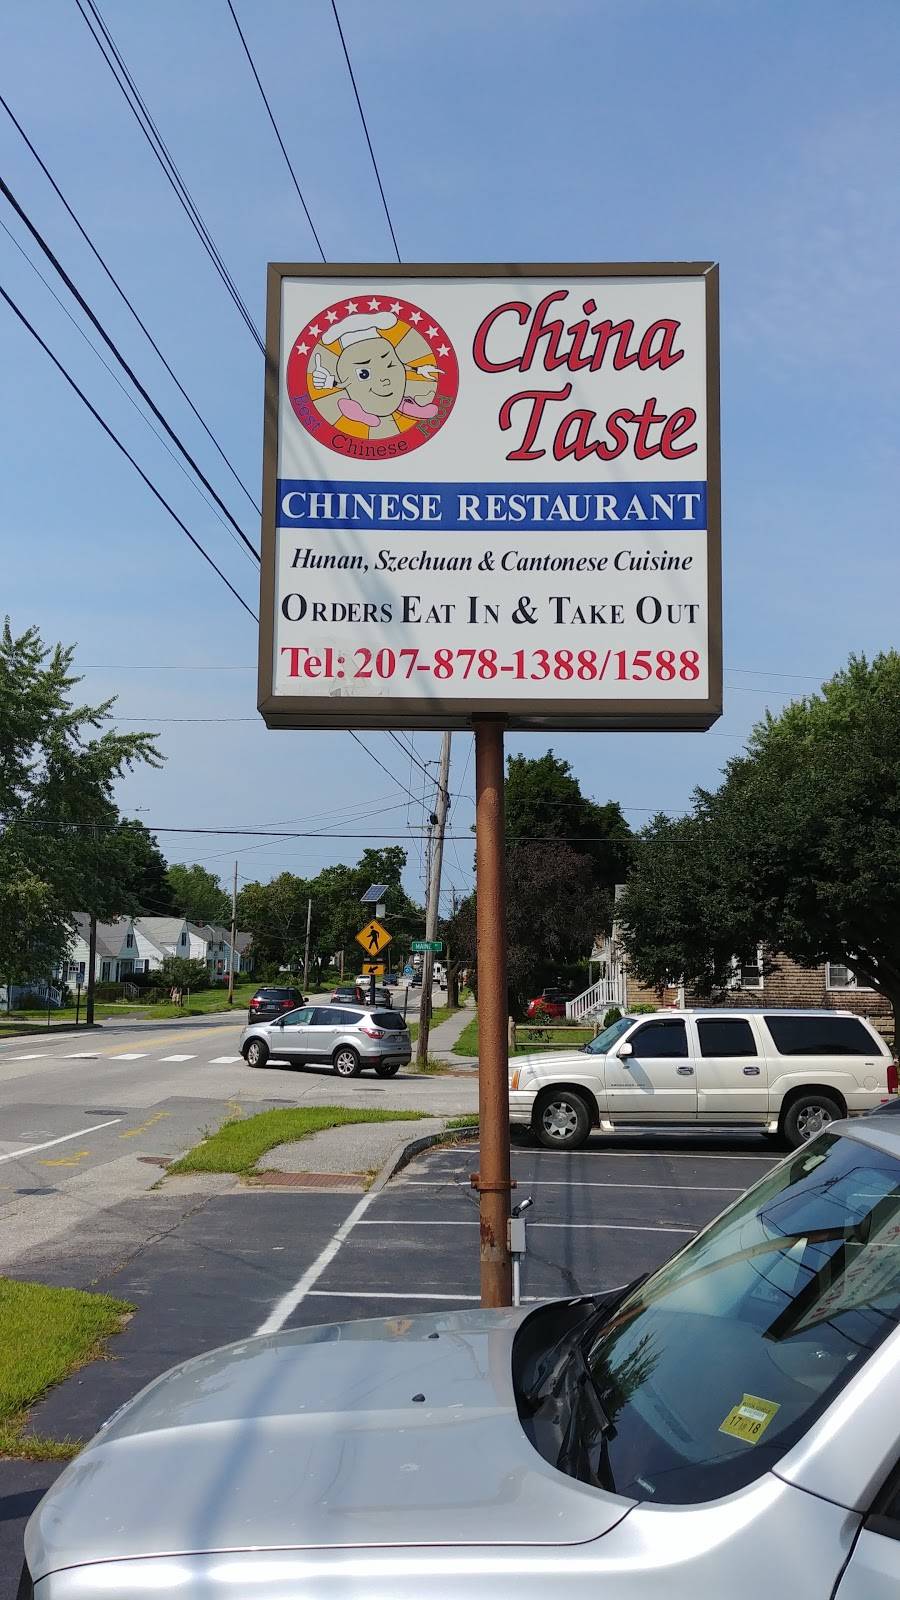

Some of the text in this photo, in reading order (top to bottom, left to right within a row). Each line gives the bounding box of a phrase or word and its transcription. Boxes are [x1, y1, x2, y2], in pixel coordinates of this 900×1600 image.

[472, 289, 685, 374] China
[294, 392, 452, 457] Best Chinese Food
[498, 382, 698, 462] Taste
[280, 491, 701, 522] CHINESE RESTAURANT
[290, 548, 693, 574] Hunan, Szechuan & Cantonese Cuisine
[281, 593, 700, 625] ORDERS EAT IN & TAKE OUT
[280, 647, 701, 681] Tel: 207-878-1388/1588
[729, 1415, 743, 1426] 17
[747, 1421, 762, 1434] 18
